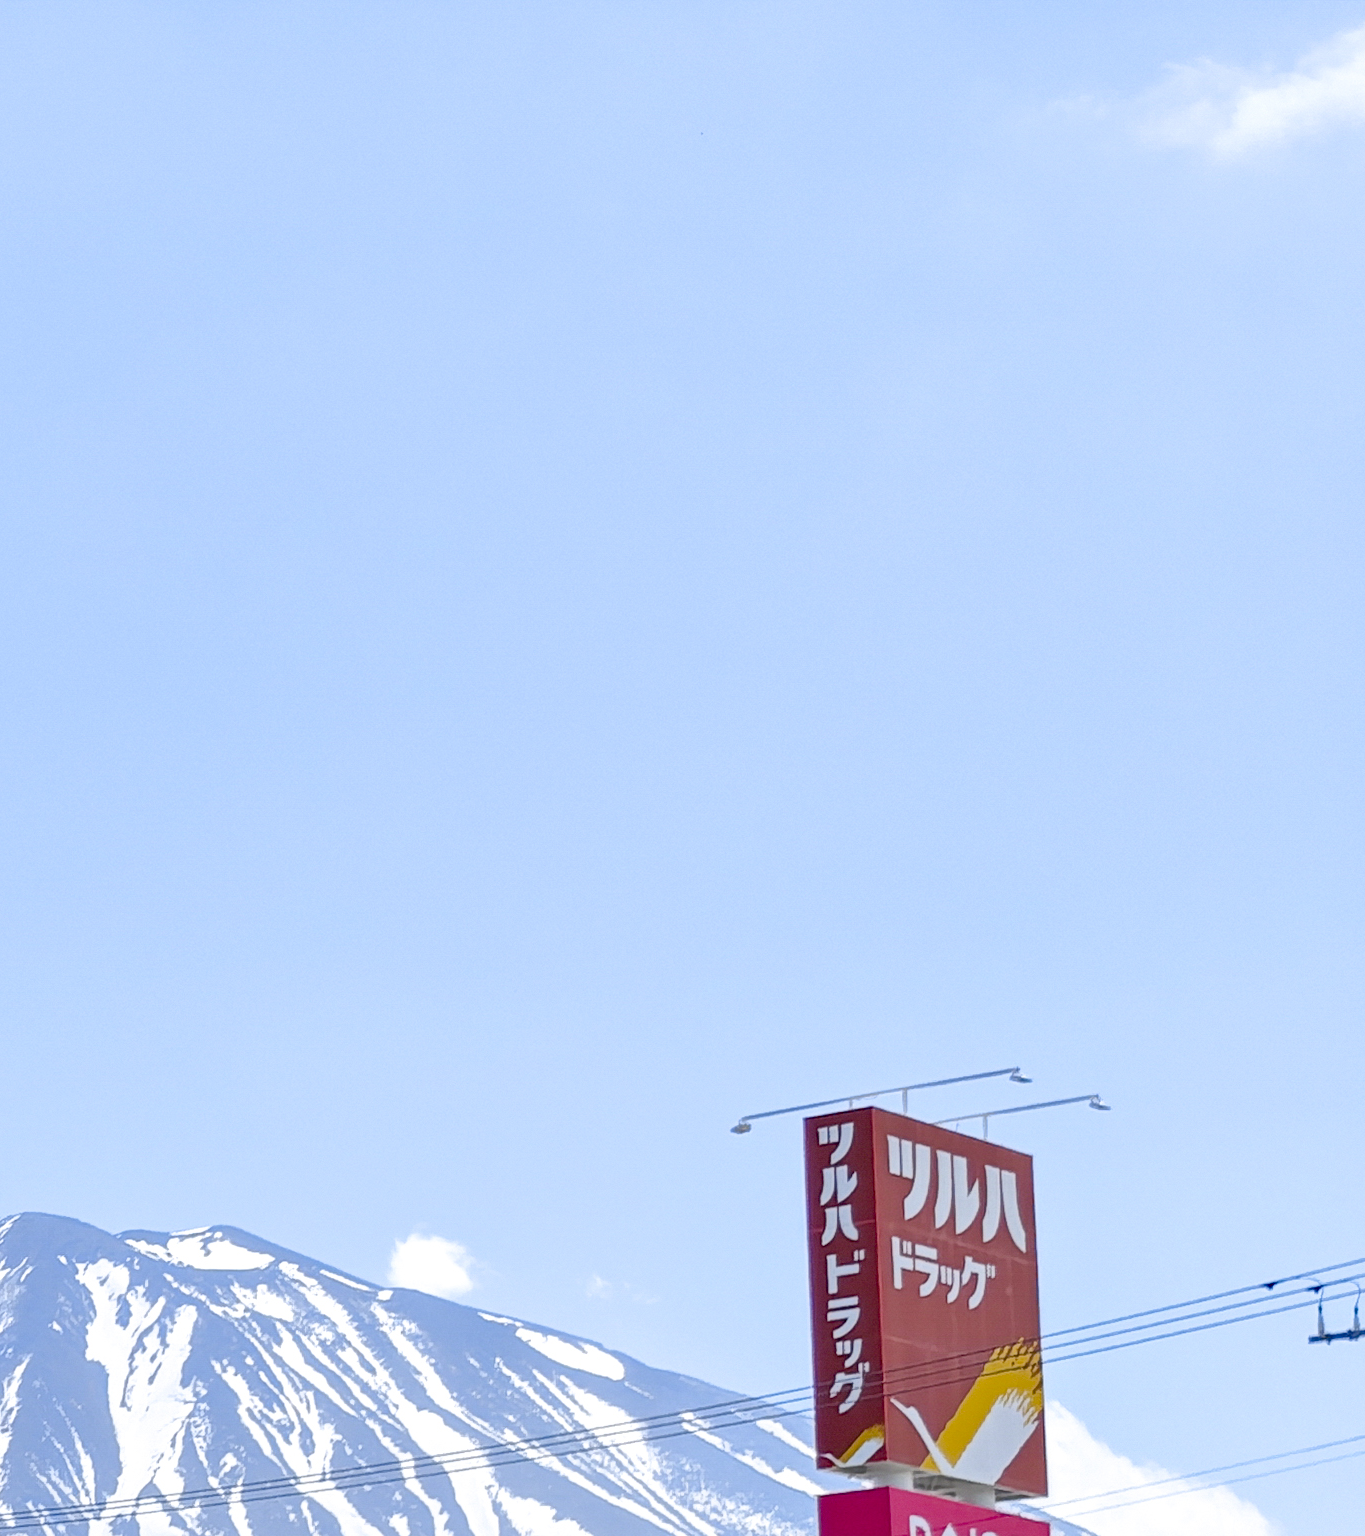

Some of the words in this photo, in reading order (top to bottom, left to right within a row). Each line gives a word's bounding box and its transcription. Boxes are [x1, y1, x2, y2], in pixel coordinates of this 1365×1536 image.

[886, 1133, 1028, 1254] ツルハ
[817, 1121, 870, 1414] ツルハドラッグ
[891, 1235, 996, 1310] ドラッグ
